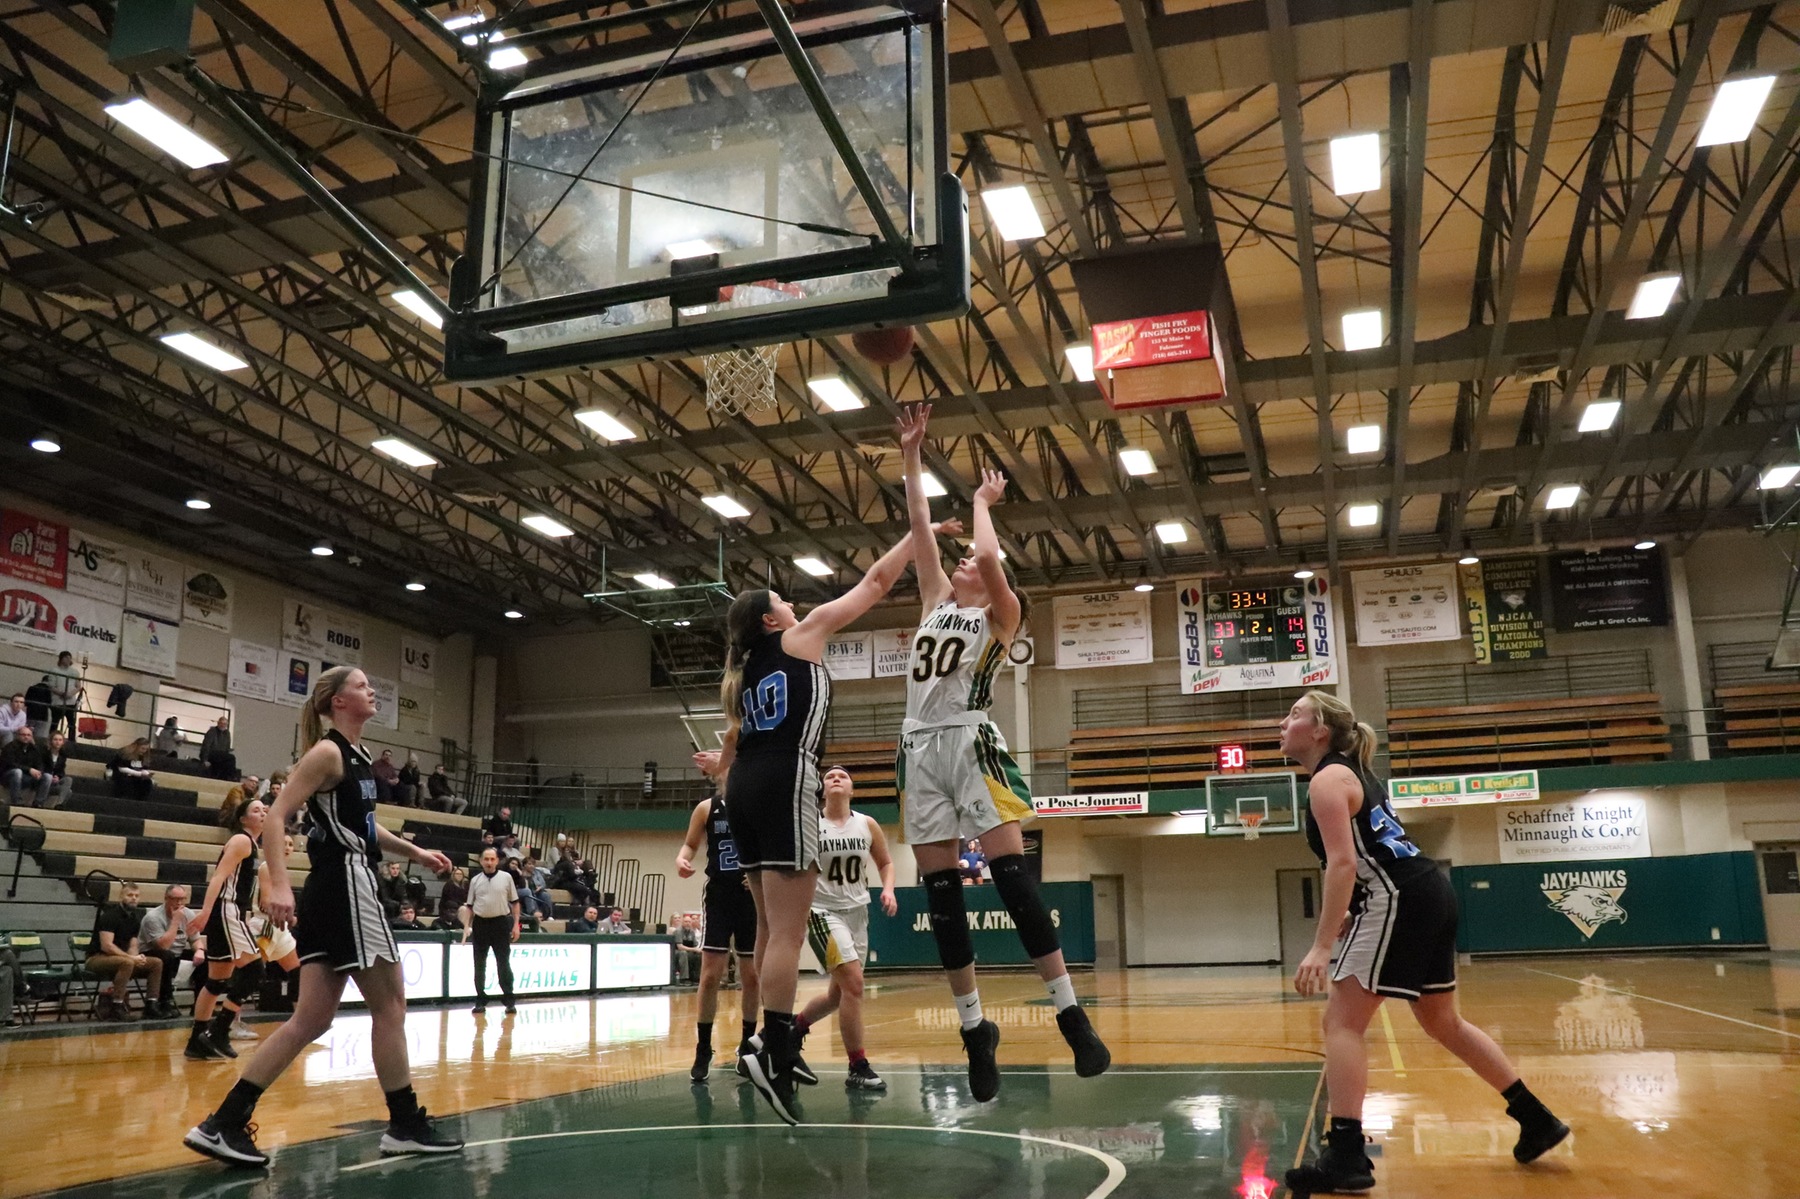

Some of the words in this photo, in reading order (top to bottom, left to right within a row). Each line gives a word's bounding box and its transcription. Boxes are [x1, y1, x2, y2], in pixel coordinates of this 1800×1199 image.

[1140, 329, 1170, 338] FINGER
[1172, 325, 1201, 334] FOODS
[1152, 321, 1170, 330] FISH
[1172, 320, 1188, 328] FRY
[1098, 322, 1135, 347] TASTA
[1485, 560, 1537, 570] JAMESTOWN
[1384, 567, 1423, 578] SHULTS
[1485, 570, 1537, 580] COMMUNITY
[1493, 580, 1532, 590] COLLEGE
[1083, 592, 1120, 604] SHULTS
[1232, 592, 1267, 609] 33.4
[1205, 611, 1242, 622] JAYHAWKS
[1276, 606, 1302, 616] GUEST
[1498, 612, 1534, 622] NJCAA
[1214, 621, 1235, 638] 33
[1252, 621, 1260, 634] 2
[1288, 618, 1304, 632] 14
[1312, 601, 1330, 657] PEPSI
[1490, 622, 1528, 632] DIVISION
[327, 630, 360, 650] ROBO
[1184, 611, 1200, 666] PEPSI
[1496, 631, 1540, 641] NATIONAL
[1494, 640, 1544, 650] CHAMPIONS
[913, 636, 965, 682] 30
[1509, 650, 1531, 659] 2000
[1240, 666, 1276, 680] AQUAFINA
[742, 670, 788, 733] 10
[1221, 748, 1244, 768] 30
[1048, 793, 1141, 808] Post-Journal
[1507, 809, 1576, 825] Schaffner
[1583, 807, 1632, 824] Knight
[1504, 826, 1578, 844] Minnaugh
[1581, 826, 1595, 838] &
[1626, 826, 1641, 836] PC
[819, 838, 866, 852] JAYHAWKS
[1516, 847, 1552, 855] CERTIFIED
[1579, 844, 1632, 852] ACCOUNTANTS
[828, 855, 862, 886] 40
[1540, 870, 1627, 890] JAYHAWKS
